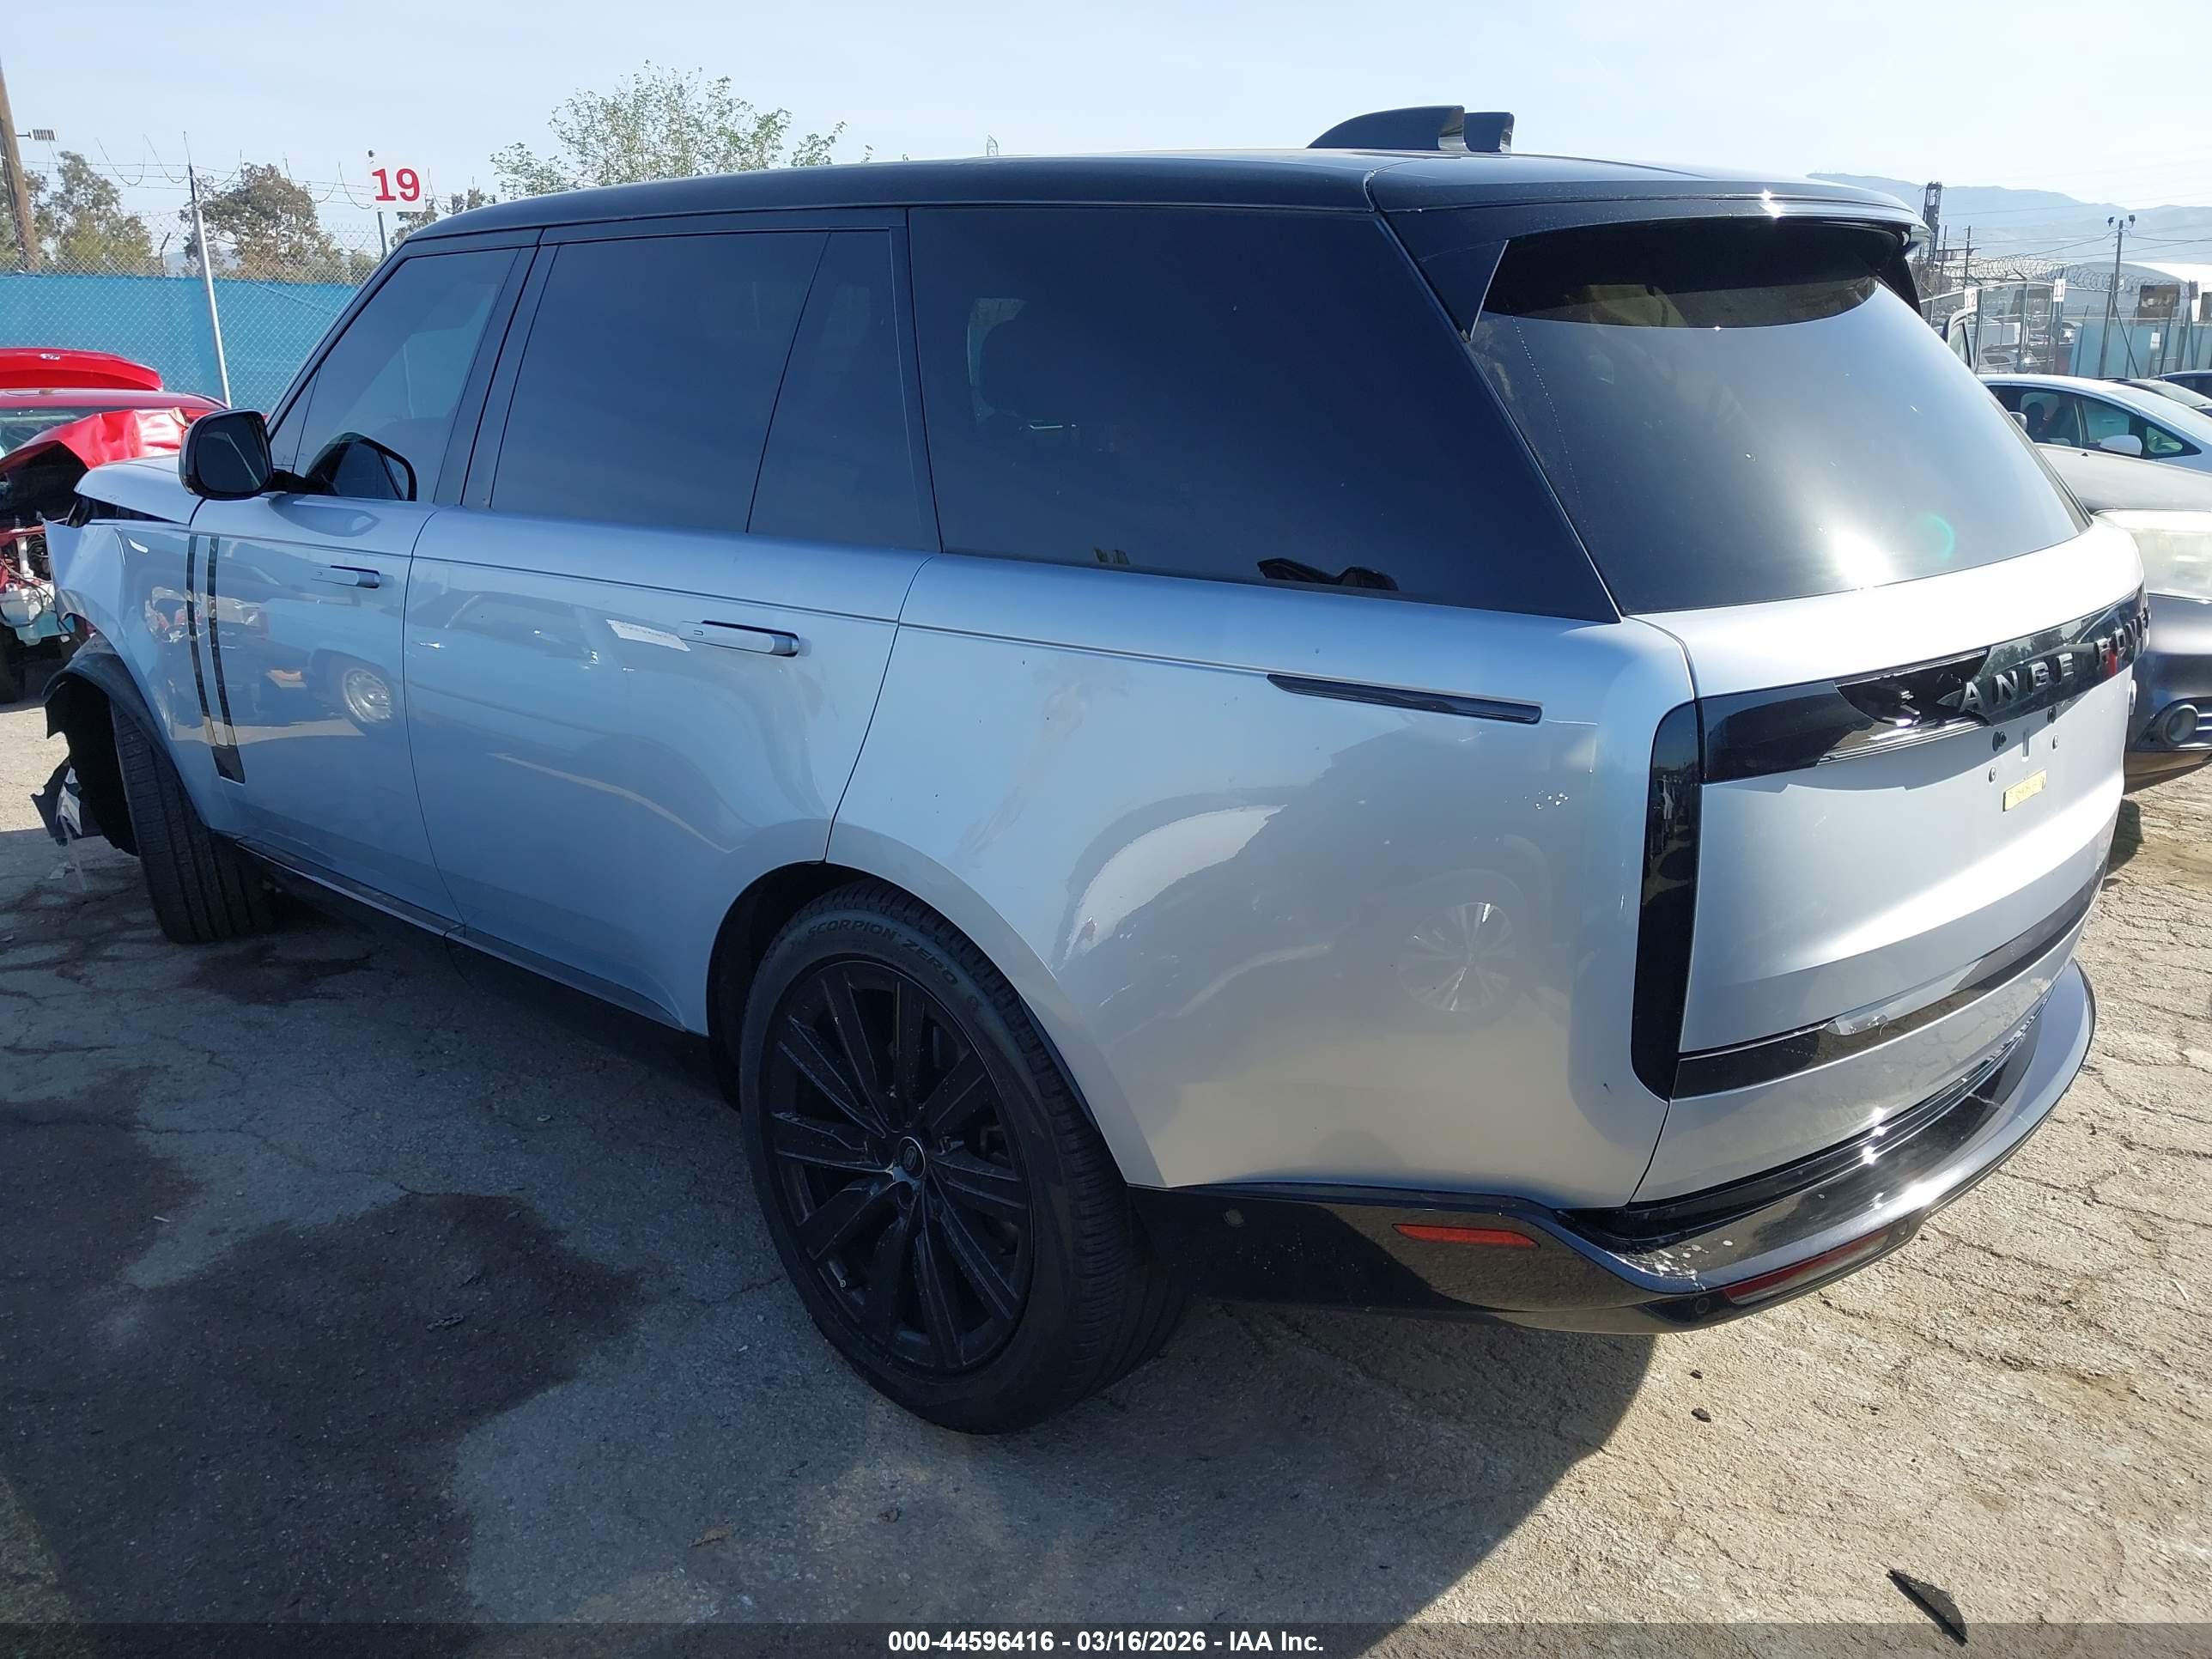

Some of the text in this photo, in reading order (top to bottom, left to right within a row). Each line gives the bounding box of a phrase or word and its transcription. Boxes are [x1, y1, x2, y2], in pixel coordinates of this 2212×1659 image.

[372, 168, 420, 202] 19
[1966, 293, 1977, 308] 12
[2055, 283, 2064, 297] 11
[808, 920, 958, 985] SCORPION ZERO
